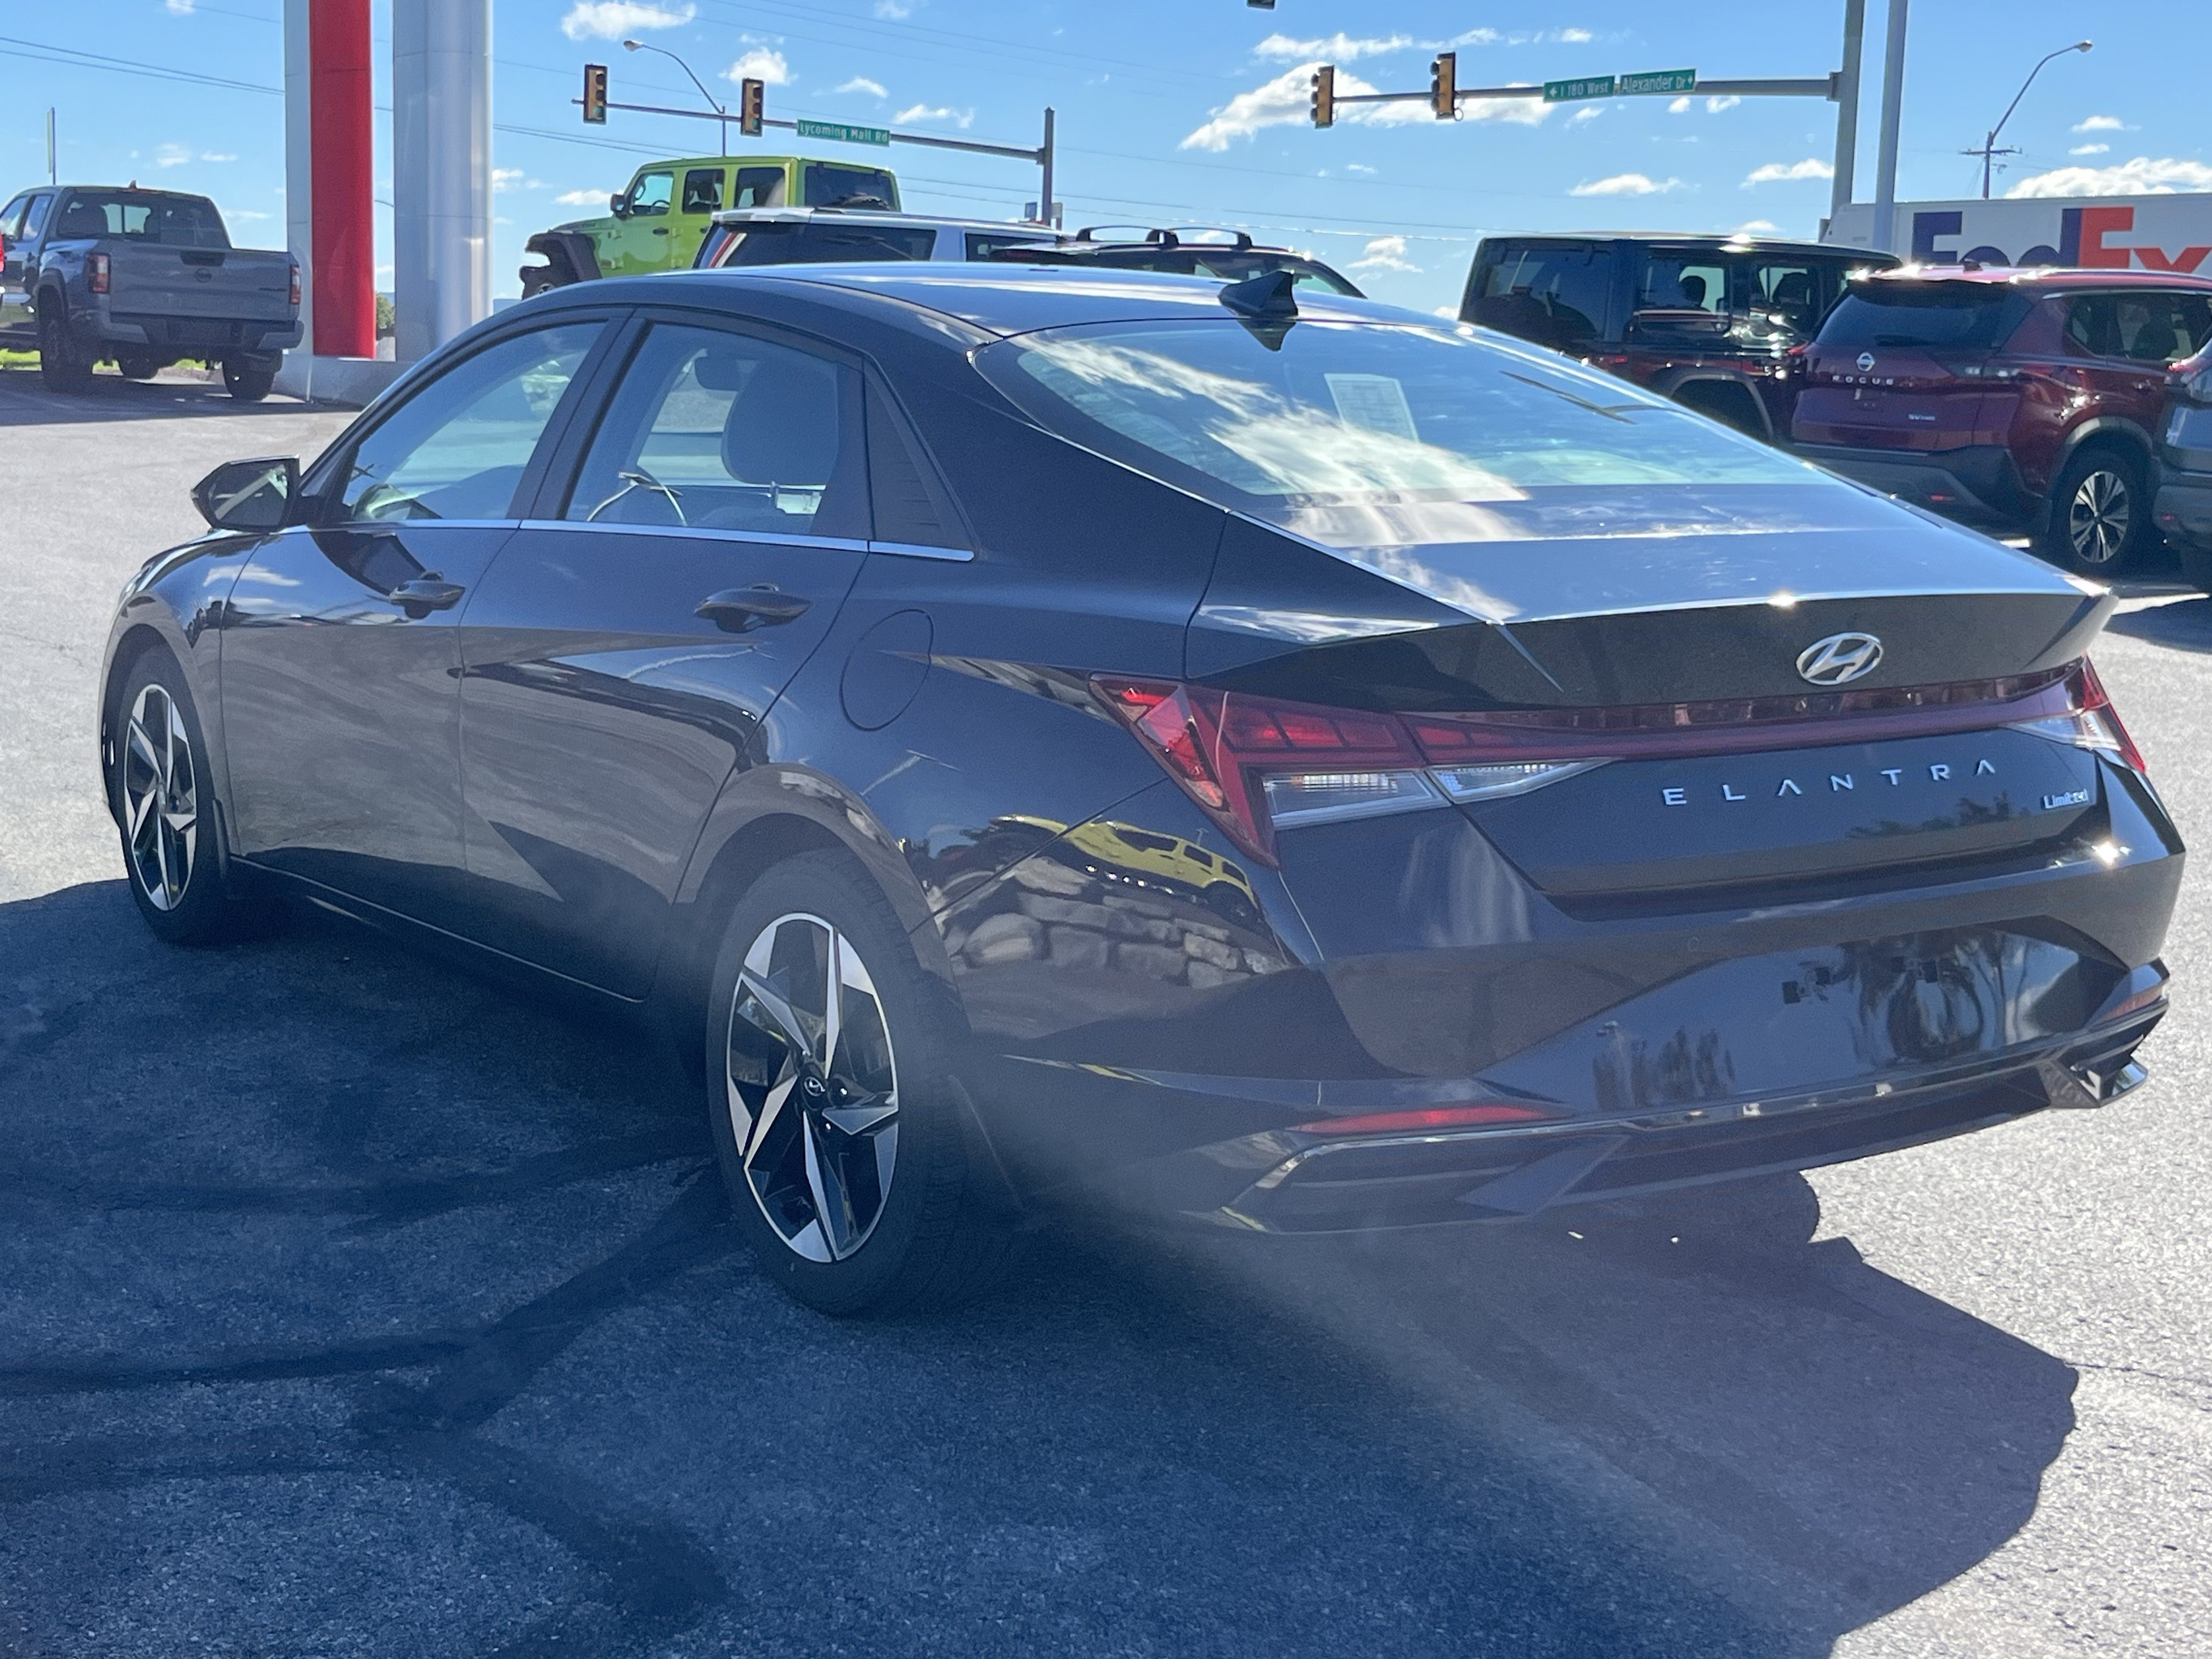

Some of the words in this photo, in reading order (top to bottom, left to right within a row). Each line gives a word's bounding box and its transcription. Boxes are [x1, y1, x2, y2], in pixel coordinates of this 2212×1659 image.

[1567, 83, 1584, 97] 180
[1587, 81, 1609, 94] West
[1621, 75, 1674, 93] Alexander
[1676, 76, 1686, 89] Dr
[800, 121, 848, 140] Lycoming
[851, 128, 872, 141] Mall
[875, 131, 888, 142] Rd
[1832, 375, 1894, 386] ROGUE
[1662, 759, 1995, 805] ELANTRA
[2043, 788, 2089, 809] Limited
